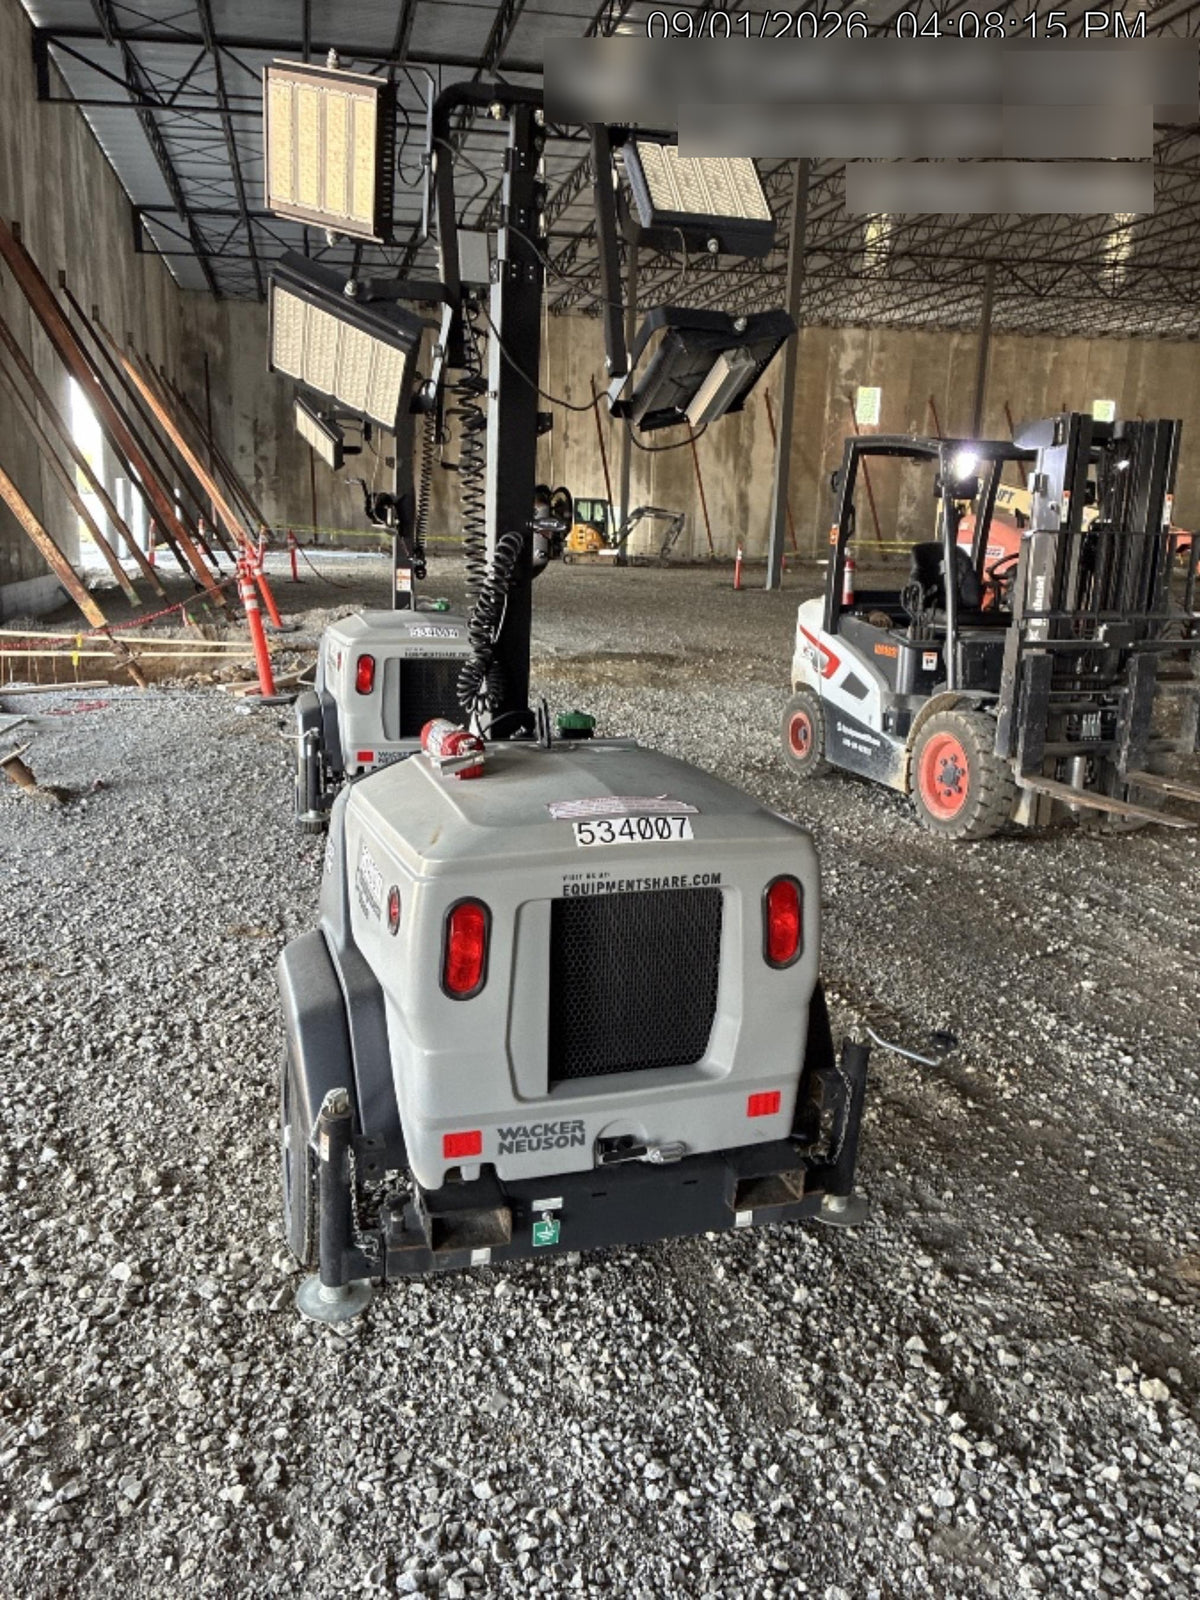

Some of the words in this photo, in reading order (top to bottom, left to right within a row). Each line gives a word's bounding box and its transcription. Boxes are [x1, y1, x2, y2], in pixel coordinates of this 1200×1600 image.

[577, 817, 687, 845] 534007
[562, 872, 722, 897] EQUIPMENTSHARE.COM
[496, 1119, 585, 1141] WACKER
[498, 1133, 585, 1155] NEUSON
